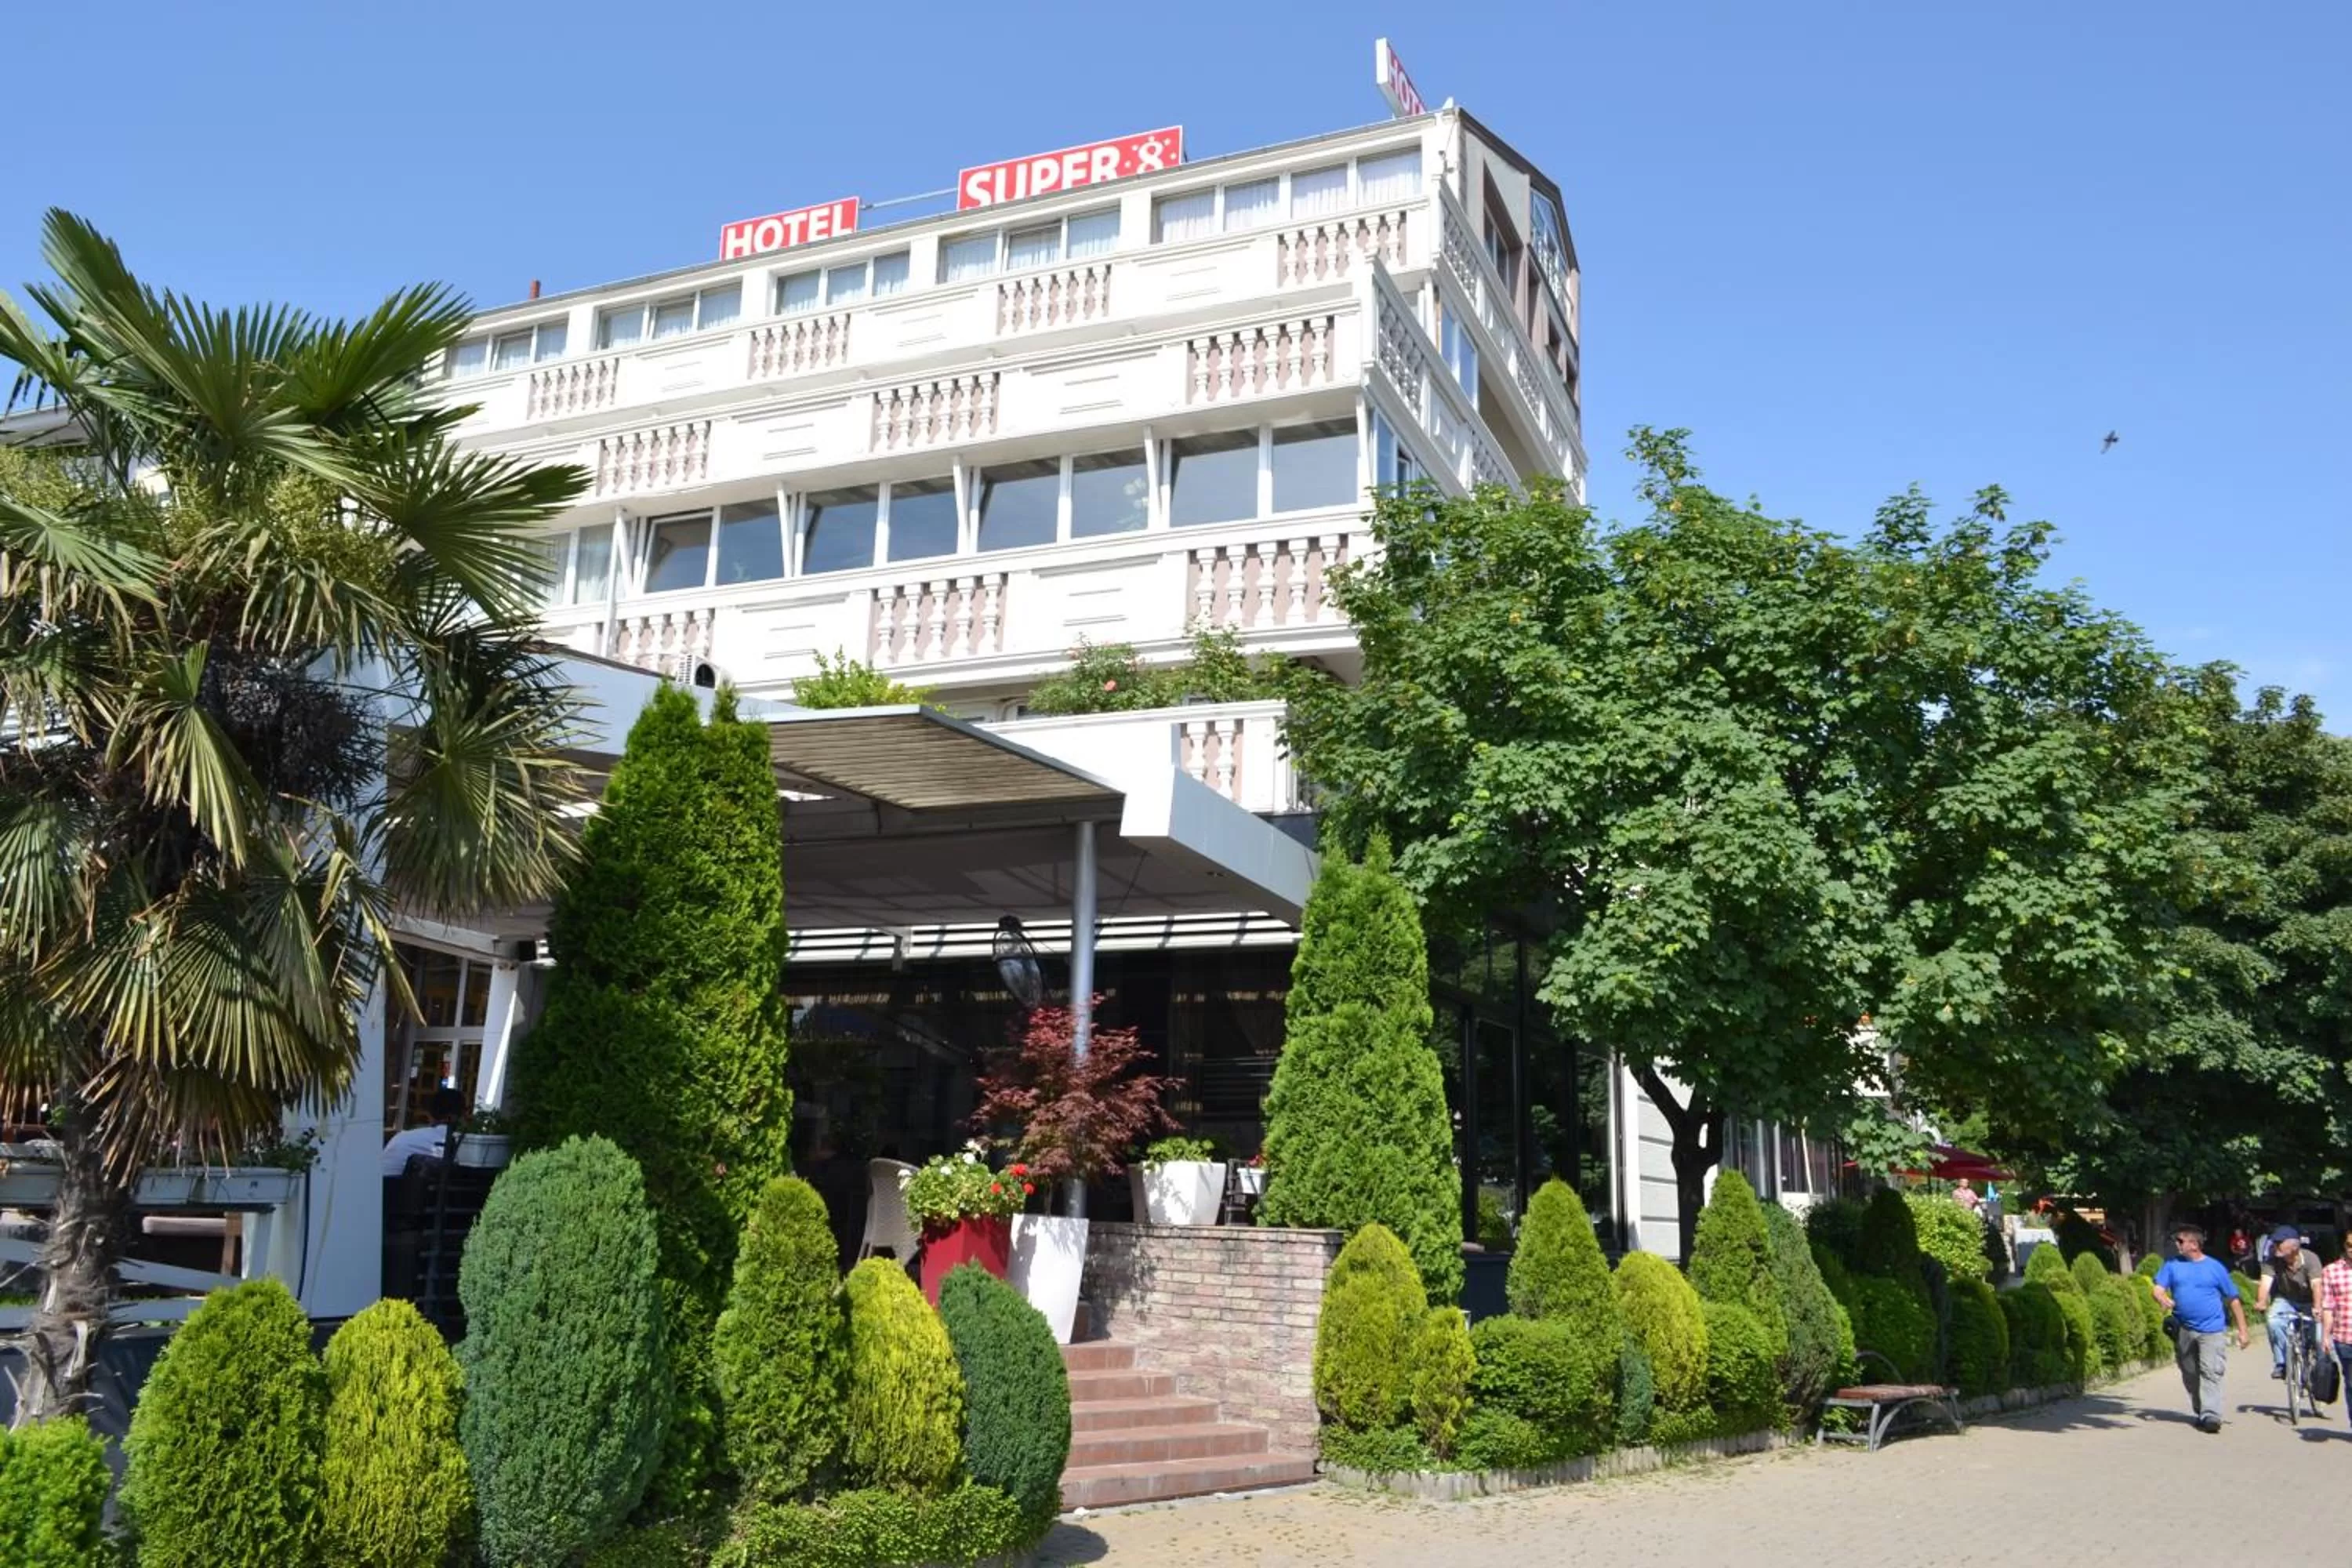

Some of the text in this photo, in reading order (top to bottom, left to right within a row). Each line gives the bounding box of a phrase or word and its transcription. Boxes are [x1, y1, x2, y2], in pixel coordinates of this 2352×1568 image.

[965, 140, 1164, 207] SUPER 8
[725, 204, 854, 260] HOTEL
